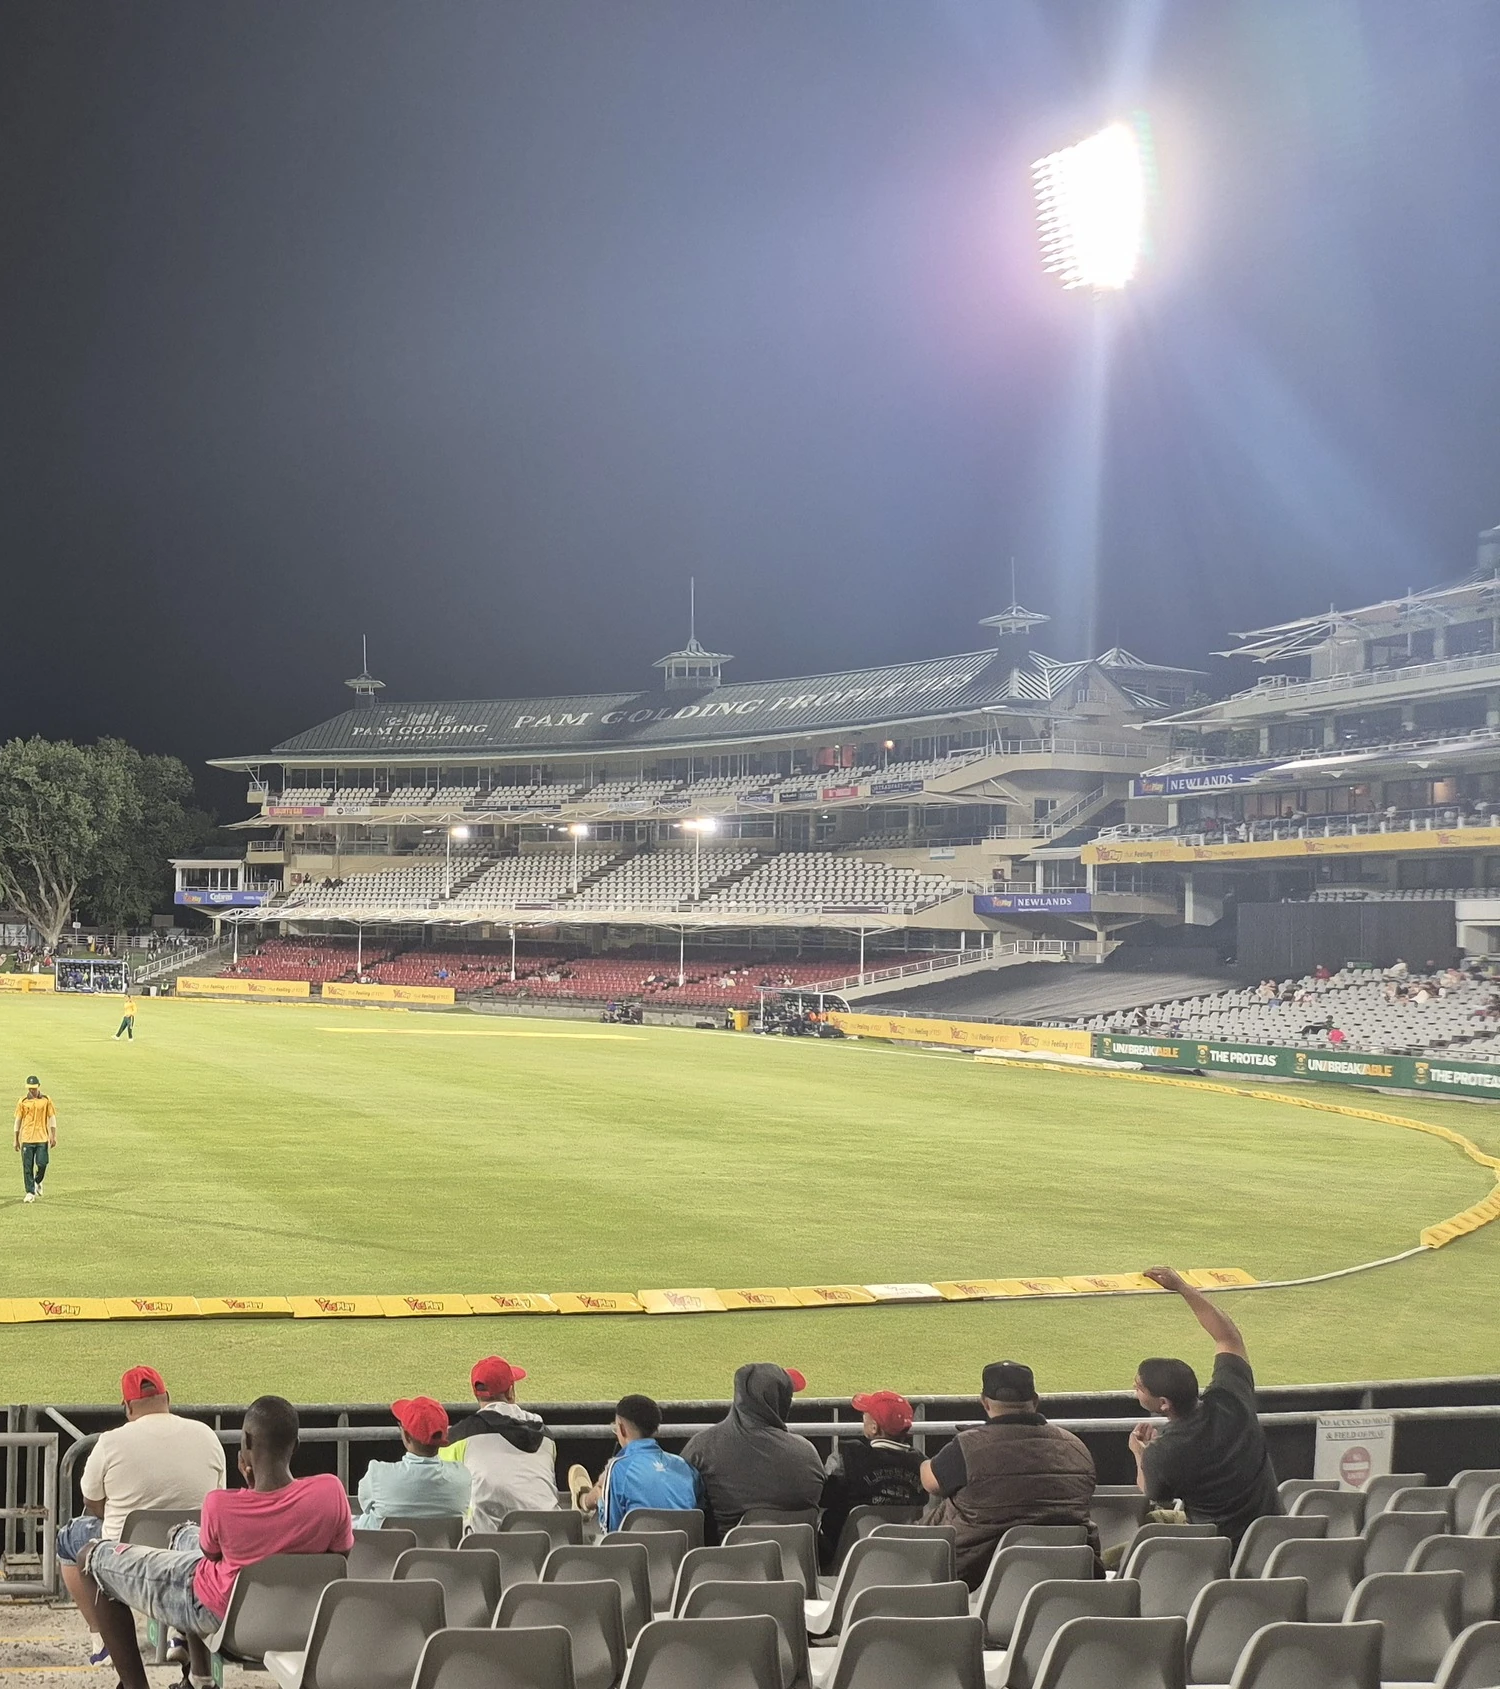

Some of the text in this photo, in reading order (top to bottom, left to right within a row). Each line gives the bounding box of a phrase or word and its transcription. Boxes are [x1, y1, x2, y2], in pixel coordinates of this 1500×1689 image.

[511, 713, 594, 729] PAM
[601, 700, 765, 725] GOLDING
[351, 724, 488, 736] PAM GOLDING
[1171, 774, 1233, 791] NEWLANDS
[1018, 898, 1072, 907] NEWLANDS
[1210, 1050, 1277, 1067] THE PROTEAS
[1430, 1069, 1454, 1084] THE
[39, 1300, 81, 1316] YesPlay
[131, 1298, 173, 1313] YesPlay
[314, 1297, 355, 1312] YesPlay
[404, 1297, 444, 1311] YesPlay
